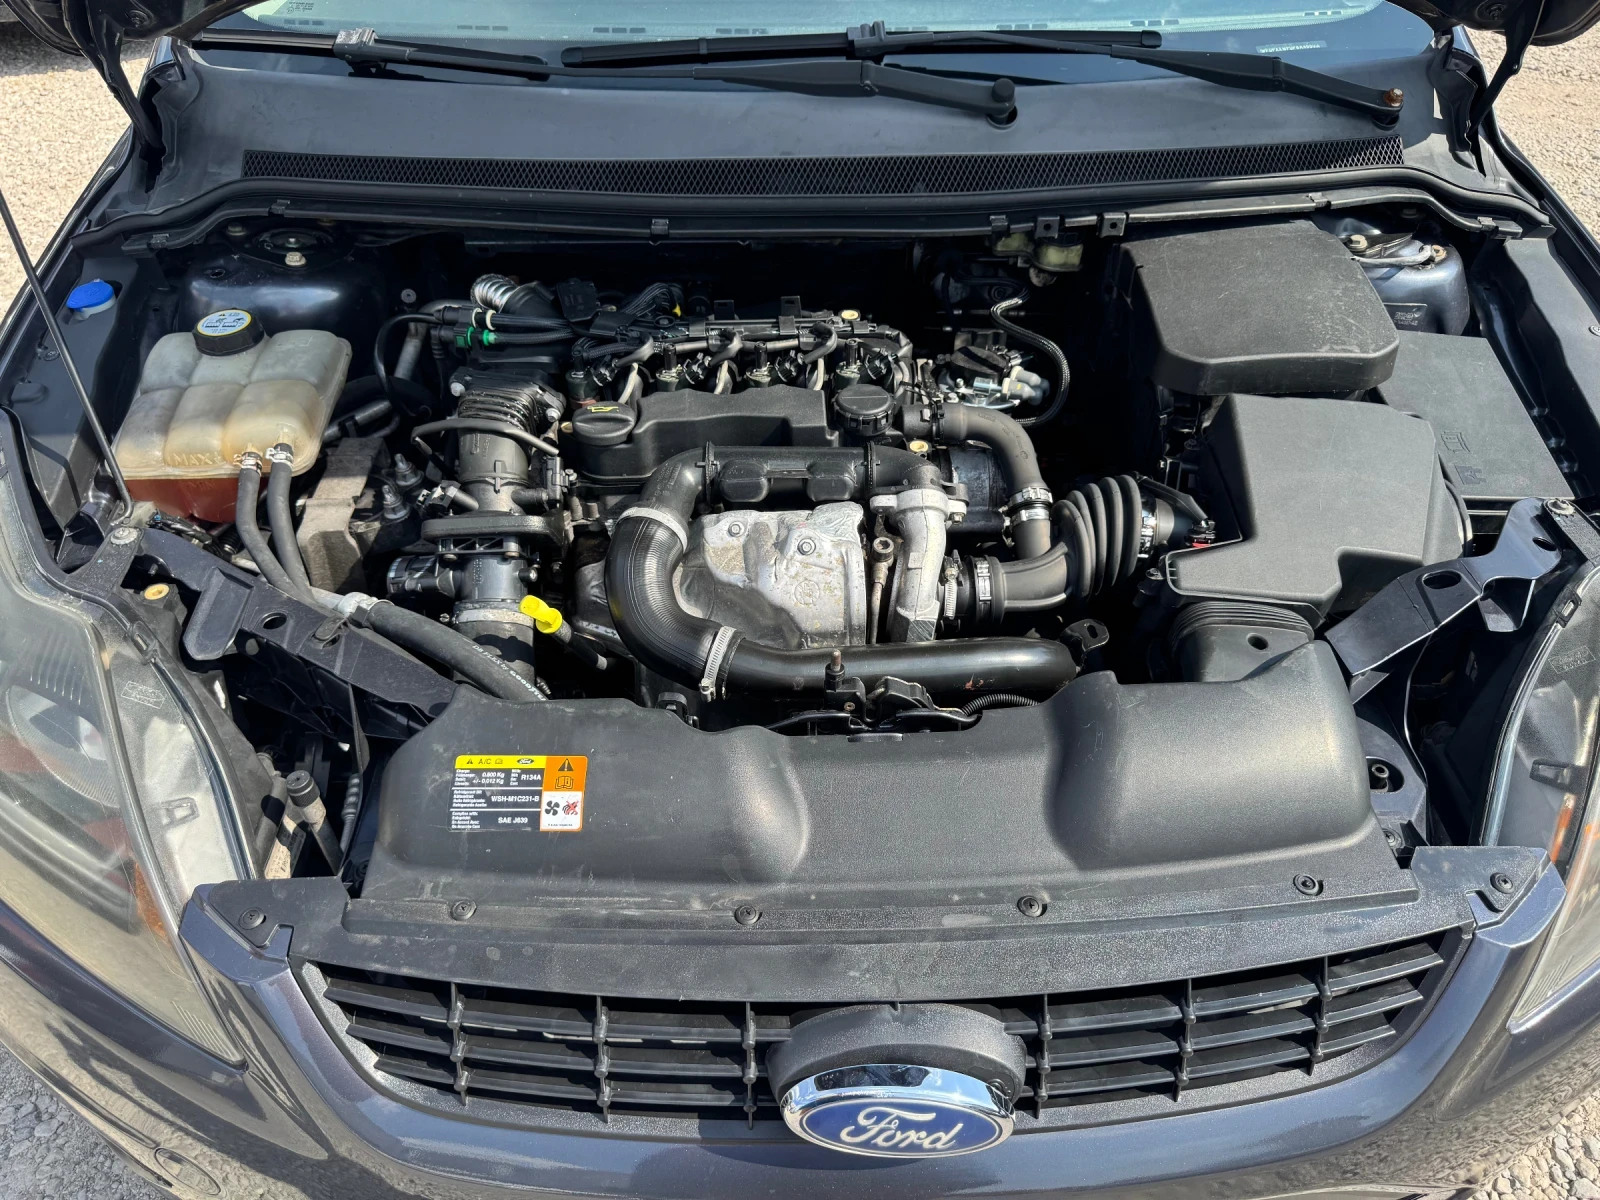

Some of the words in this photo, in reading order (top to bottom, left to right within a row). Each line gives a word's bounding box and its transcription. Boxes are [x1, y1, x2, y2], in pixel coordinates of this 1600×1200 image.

[172, 452, 213, 466] MAX
[483, 651, 502, 665] FLEX
[509, 670, 547, 701] GOODYEA
[497, 816, 512, 824] SAE
[839, 1106, 964, 1150] Ford
